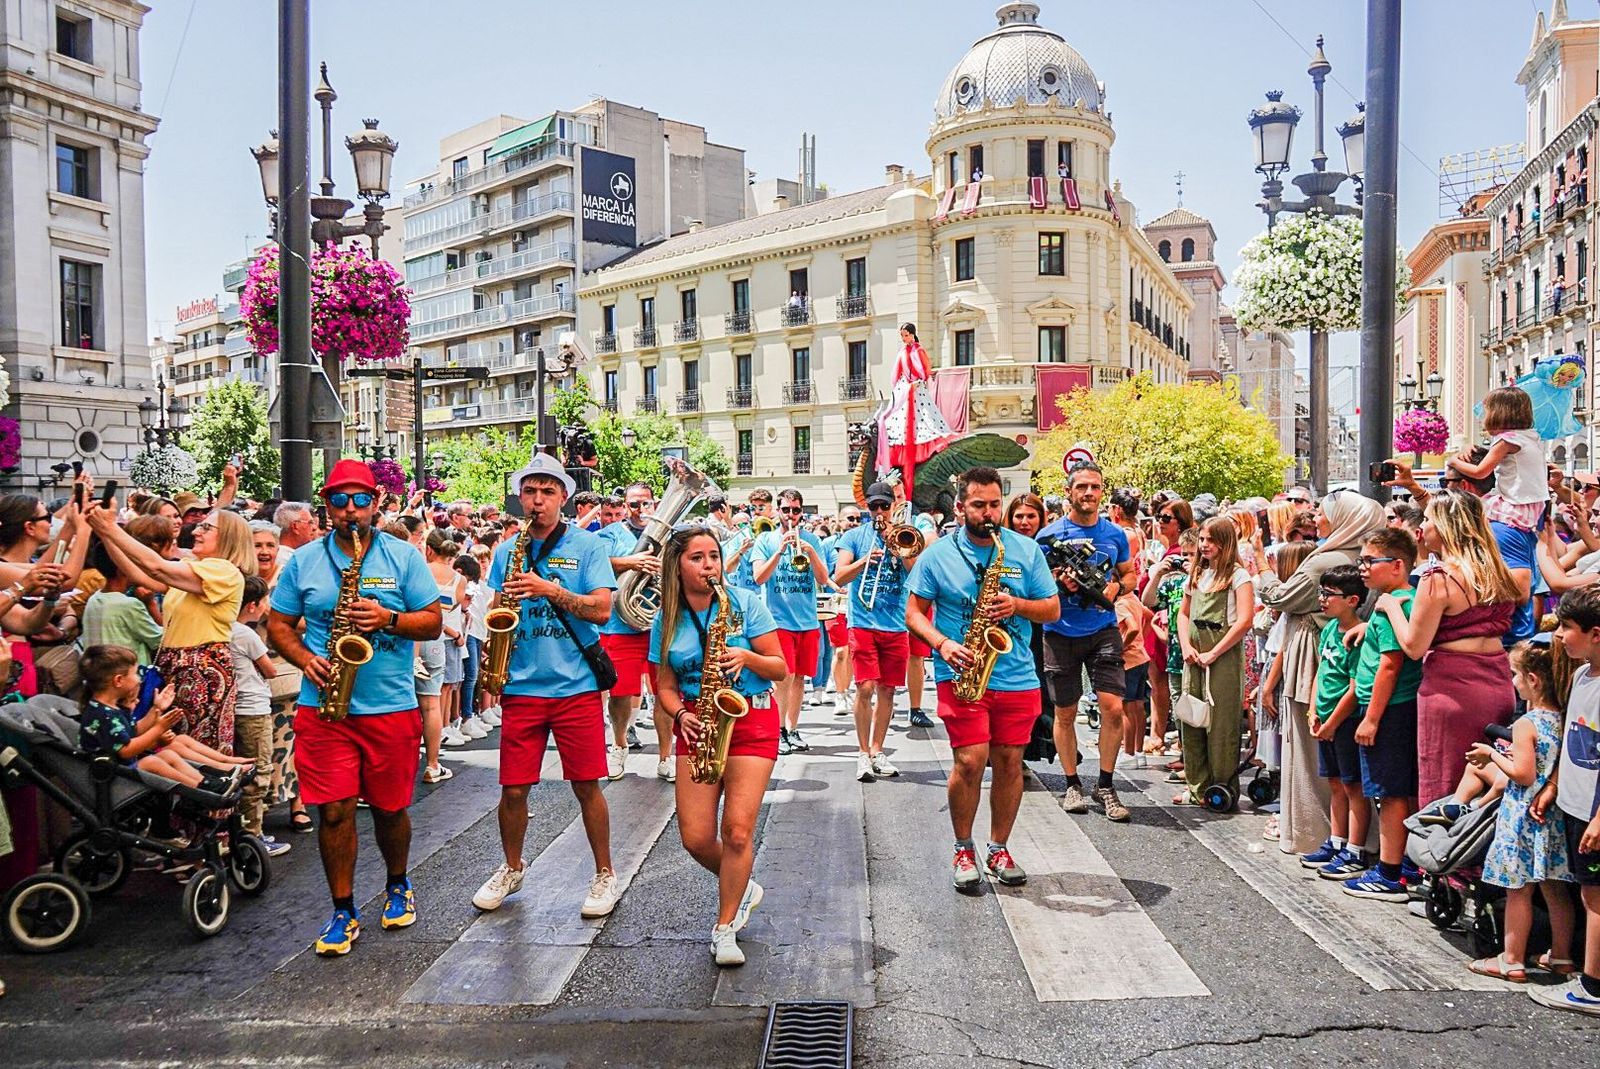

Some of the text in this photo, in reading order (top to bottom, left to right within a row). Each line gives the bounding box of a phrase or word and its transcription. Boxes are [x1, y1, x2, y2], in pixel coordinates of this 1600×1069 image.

[583, 194, 635, 215] MARCA LA
[583, 209, 636, 227] DIFERENCIA
